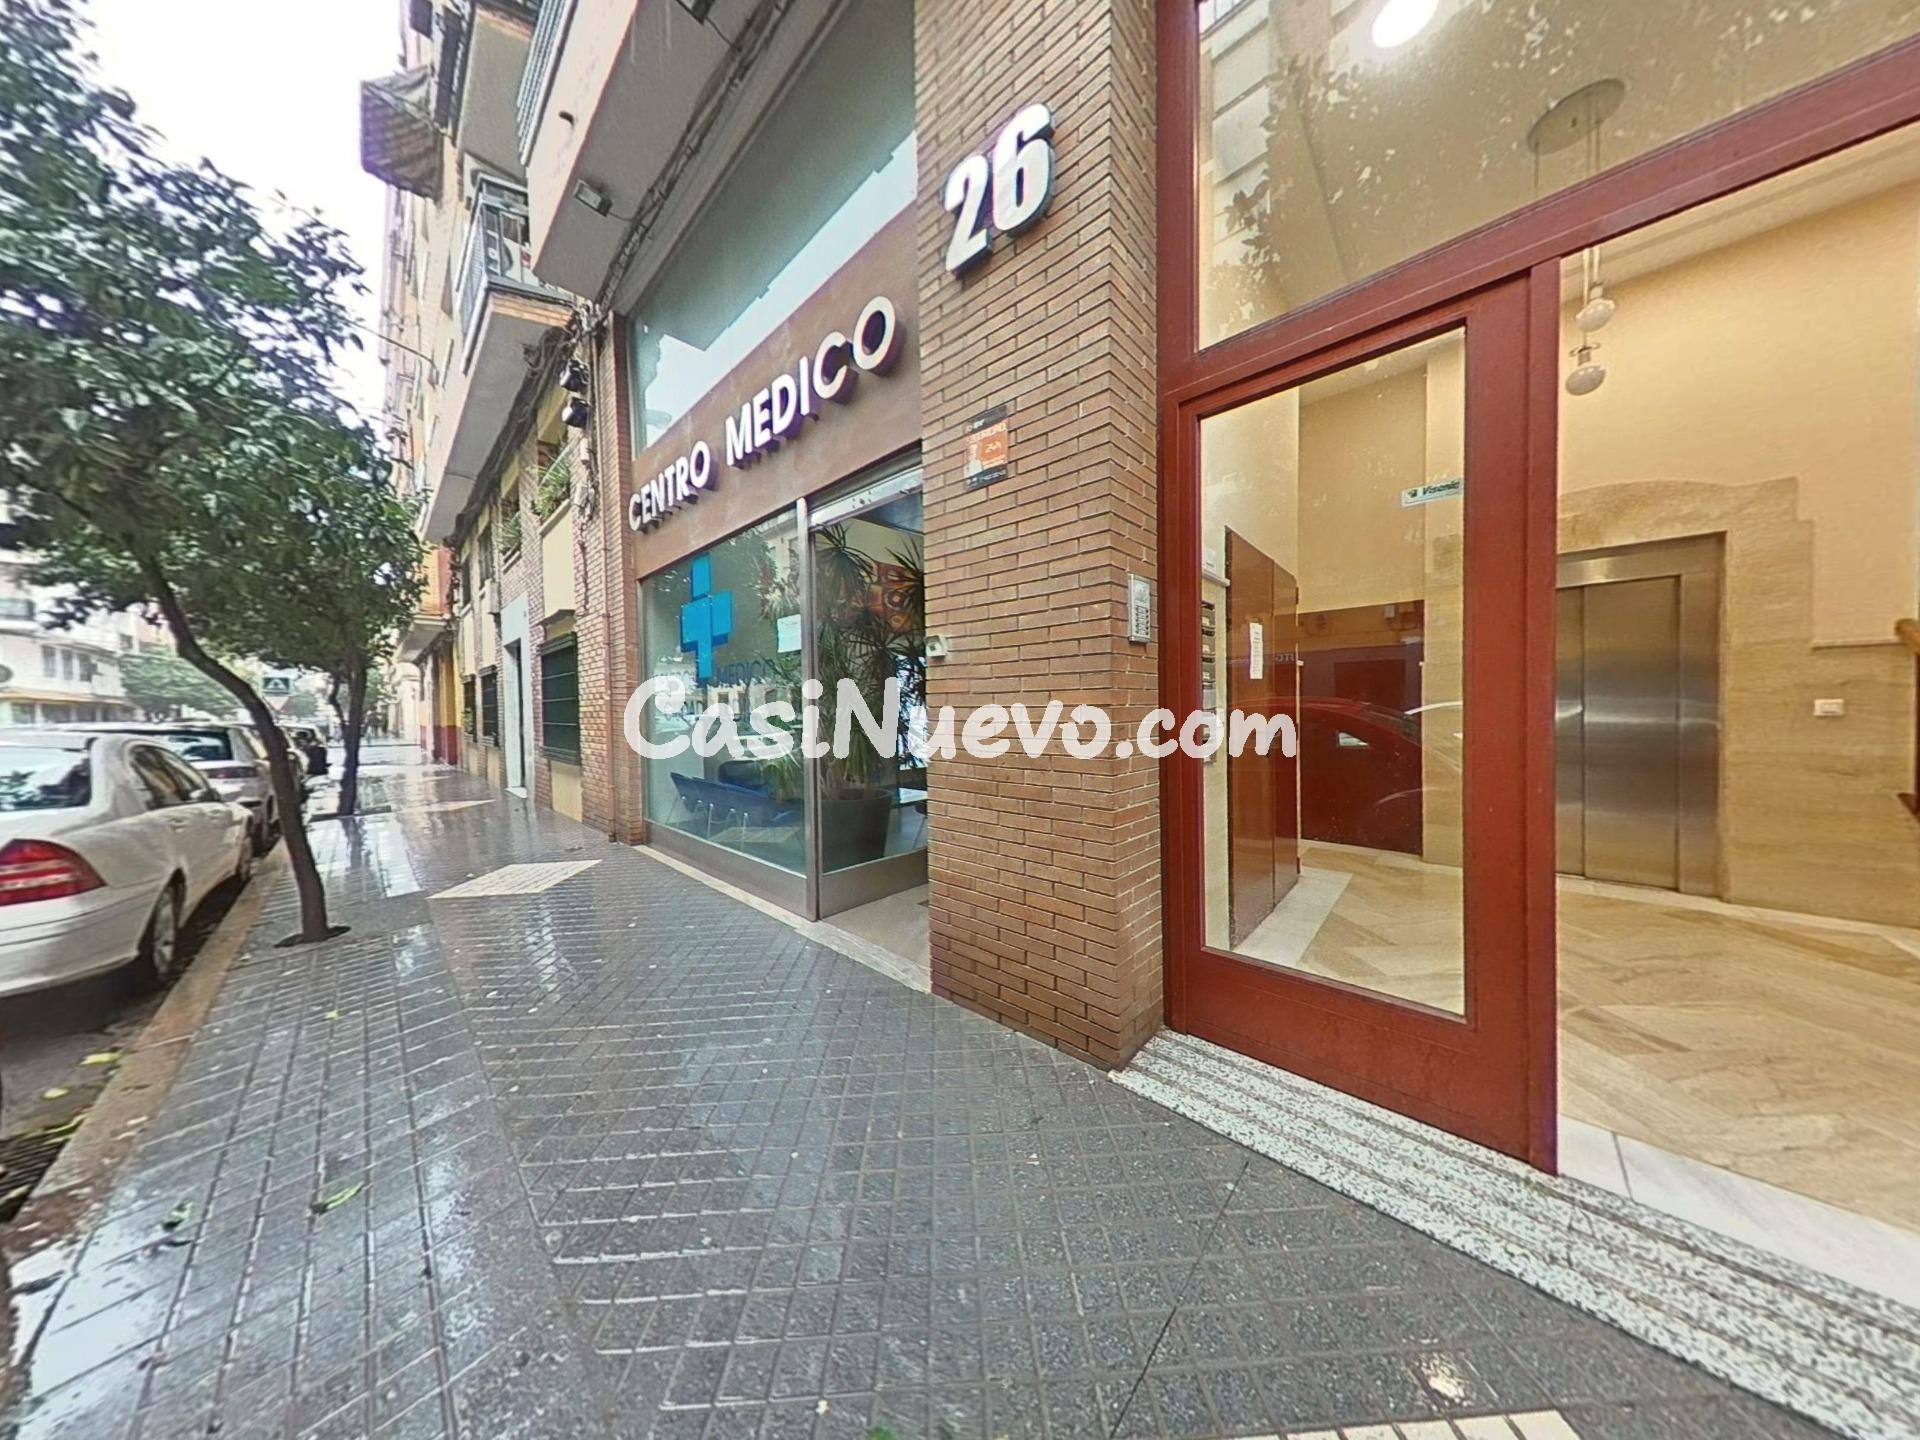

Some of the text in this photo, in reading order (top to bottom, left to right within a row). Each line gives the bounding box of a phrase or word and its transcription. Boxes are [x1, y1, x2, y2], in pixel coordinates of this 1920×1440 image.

[944, 103, 1055, 274] 26
[629, 295, 896, 531] CENTRO MEDICO
